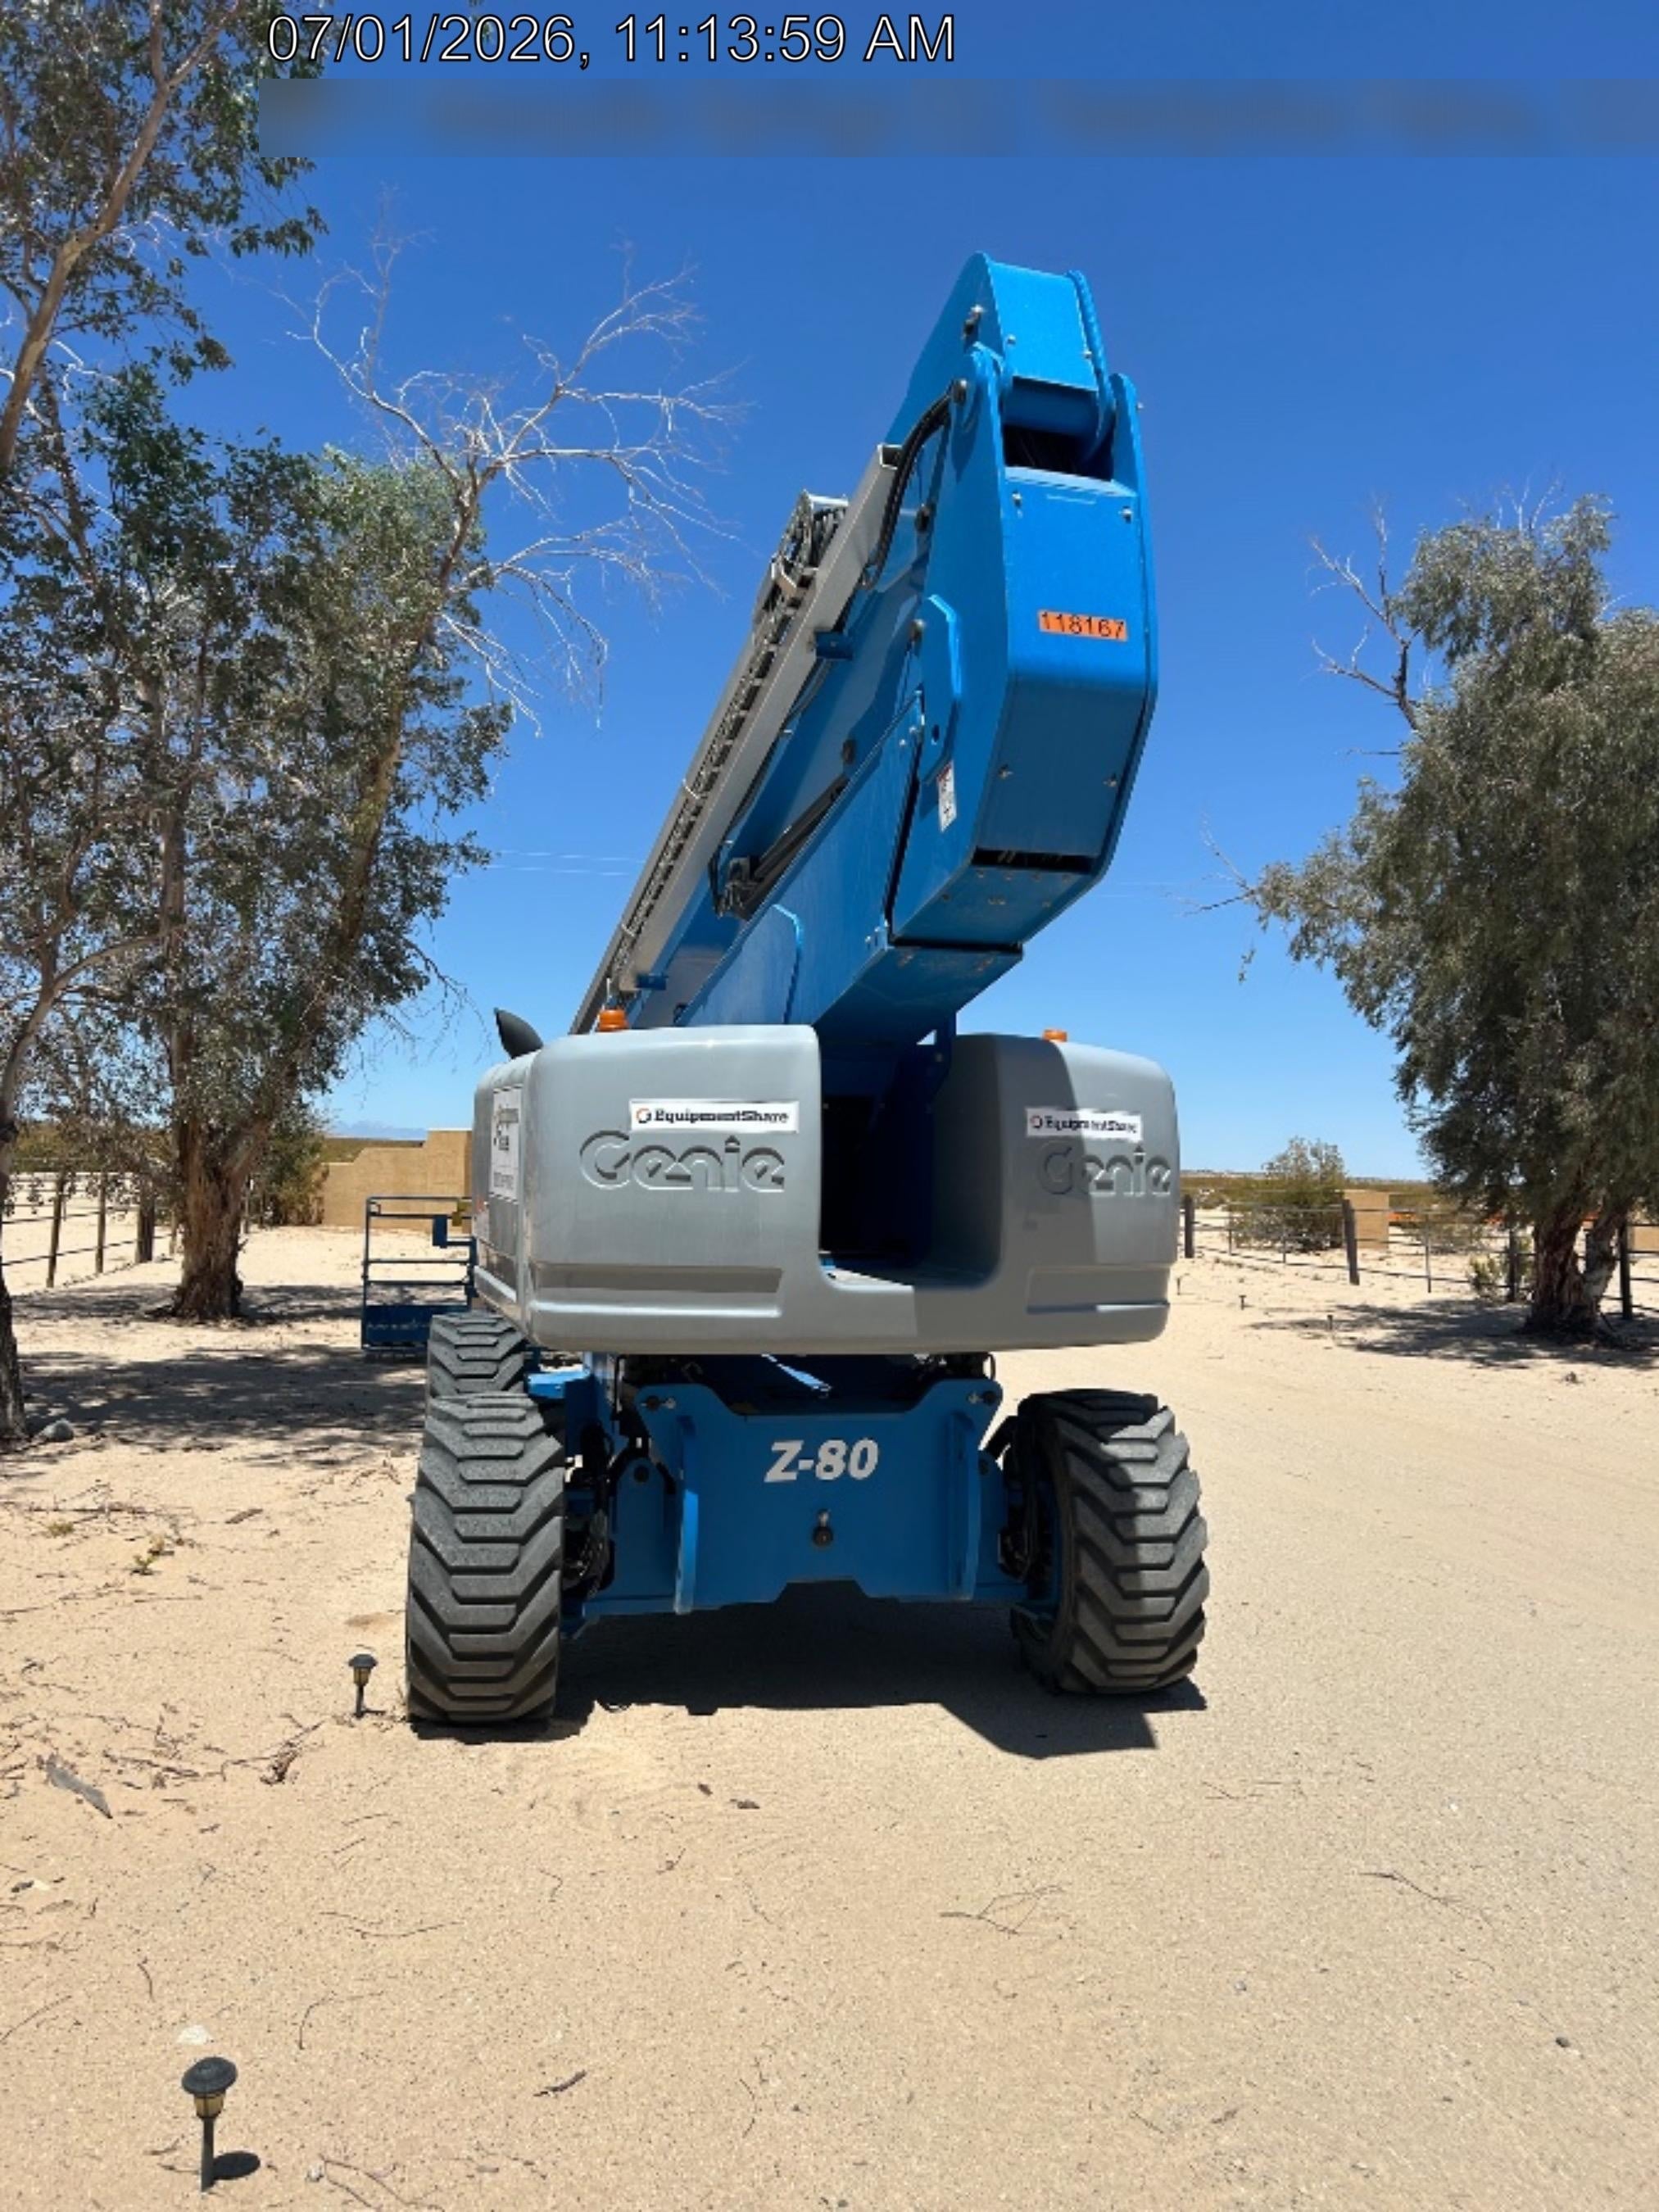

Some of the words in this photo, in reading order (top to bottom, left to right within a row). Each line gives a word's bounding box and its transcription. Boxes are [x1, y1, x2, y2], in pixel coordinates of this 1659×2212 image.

[1040, 611, 1125, 640] 118167
[579, 1130, 786, 1194] Genie
[1039, 1140, 1172, 1197] Genie
[764, 1437, 880, 1483] Z-80
